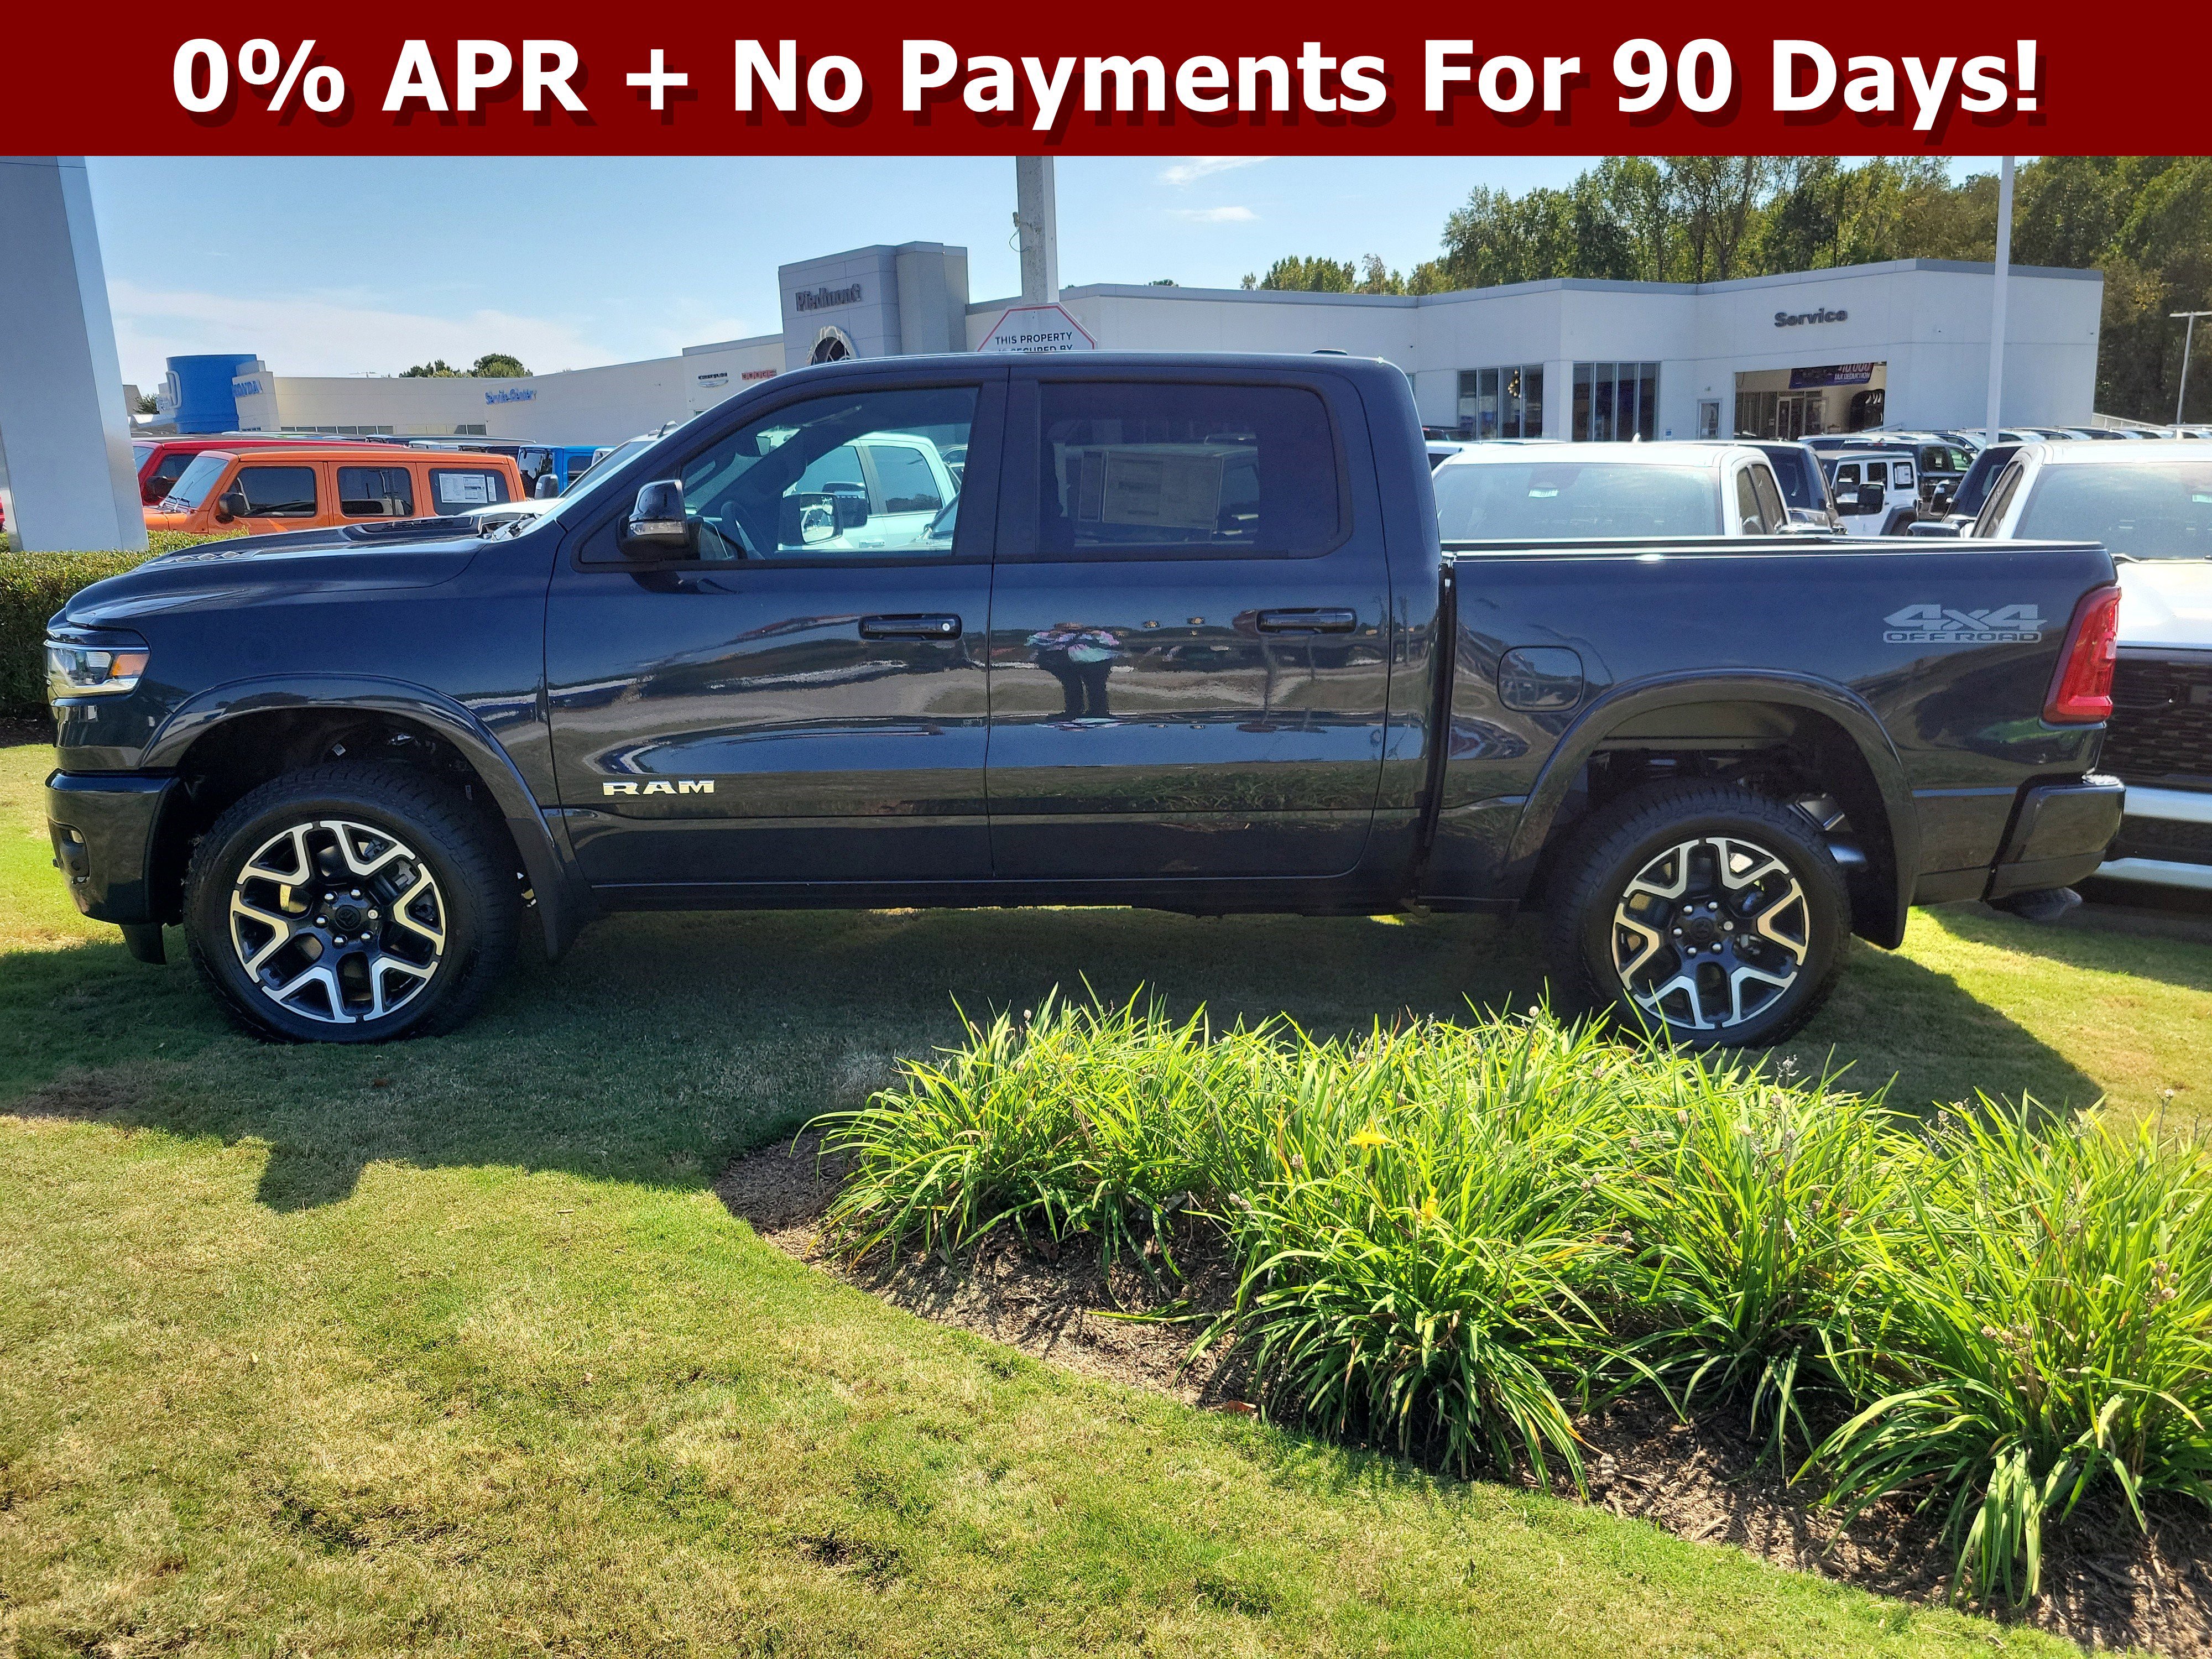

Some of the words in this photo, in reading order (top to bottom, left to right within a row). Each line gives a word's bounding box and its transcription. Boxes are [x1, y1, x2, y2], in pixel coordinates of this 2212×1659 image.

[795, 283, 861, 311] Piedmont
[1774, 307, 1848, 327] Service
[995, 336, 1017, 345] THIS
[1020, 332, 1072, 344] PROPERTY
[1886, 632, 1945, 641] OFF
[1954, 632, 2039, 641] ROAD
[603, 780, 714, 796] RAM
